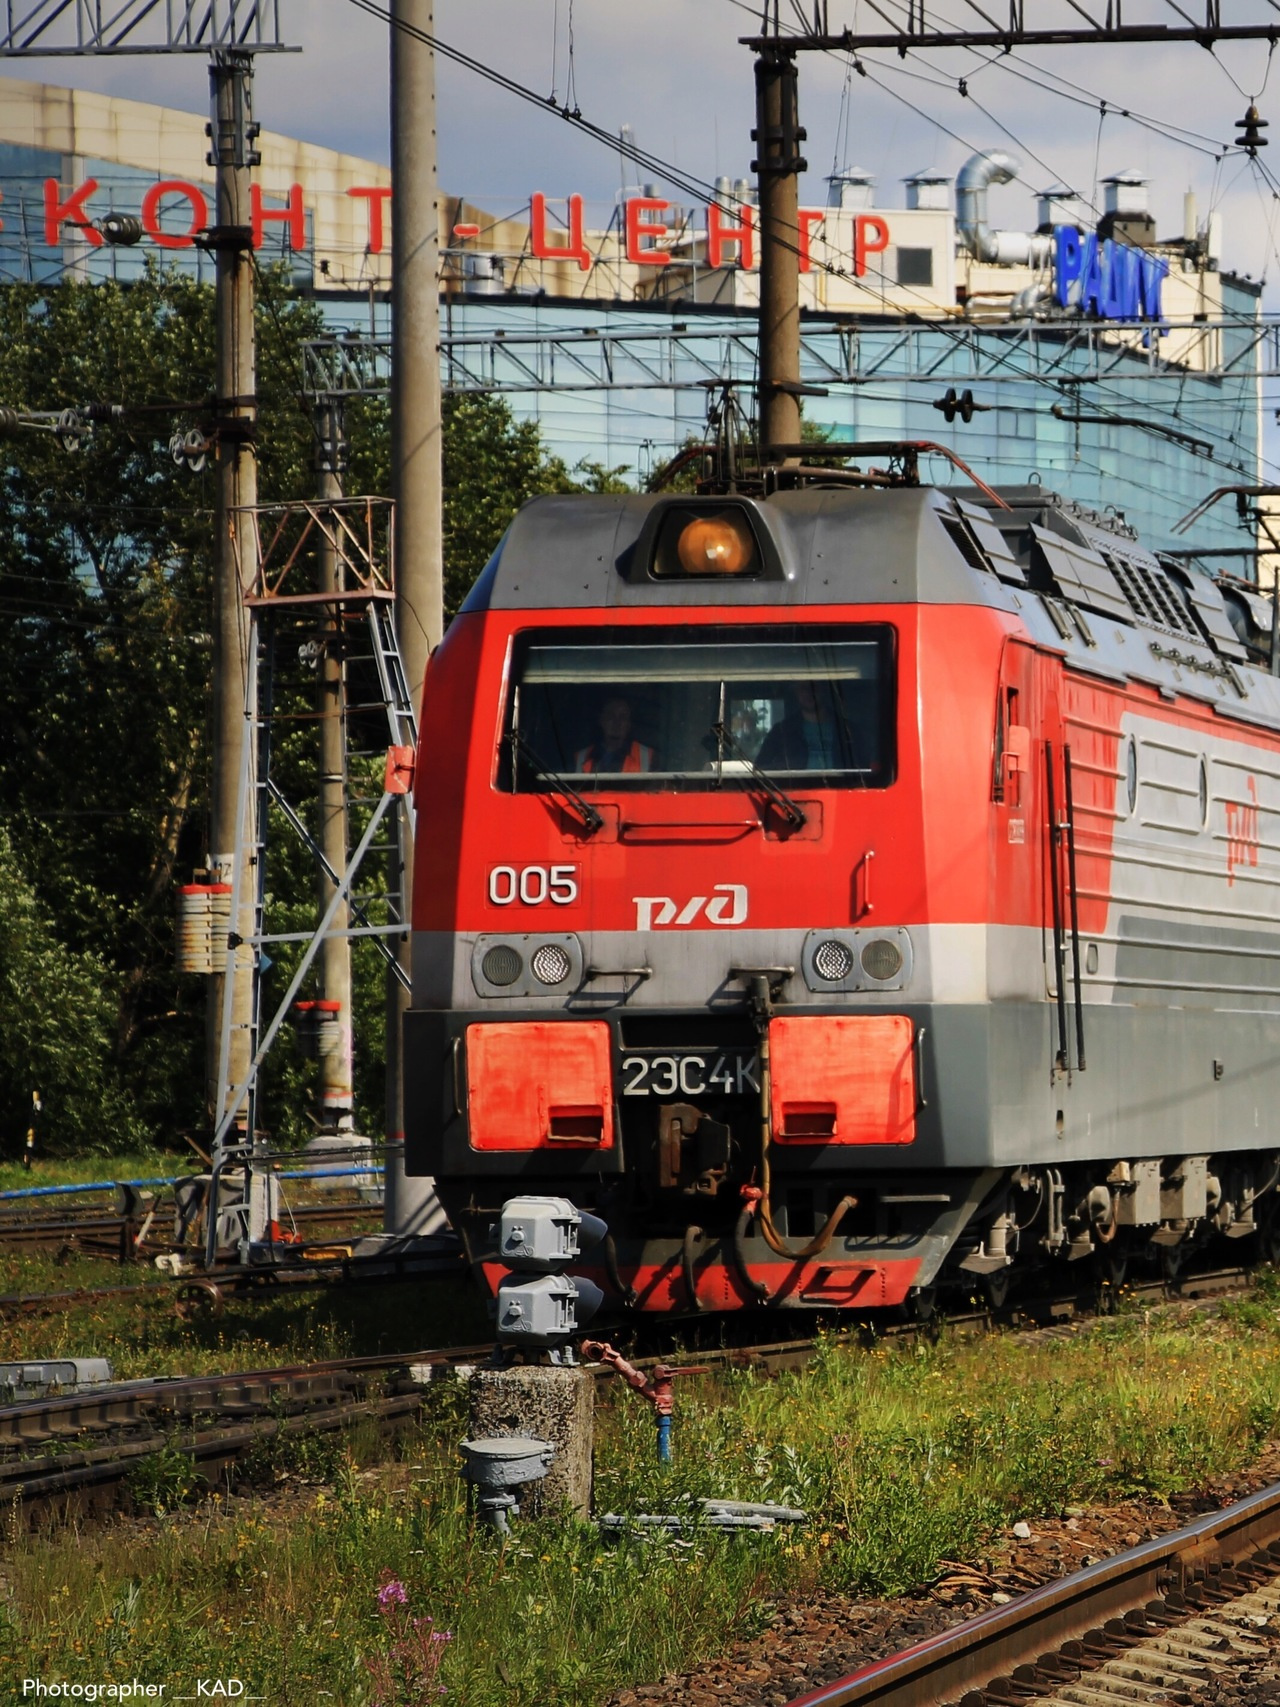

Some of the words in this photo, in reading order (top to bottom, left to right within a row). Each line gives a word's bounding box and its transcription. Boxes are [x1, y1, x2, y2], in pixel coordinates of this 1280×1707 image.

[0, 177, 890, 278] КОНТ-ЦЕНТР
[489, 865, 578, 905] 005
[622, 1056, 760, 1096] 2ЭС4К
